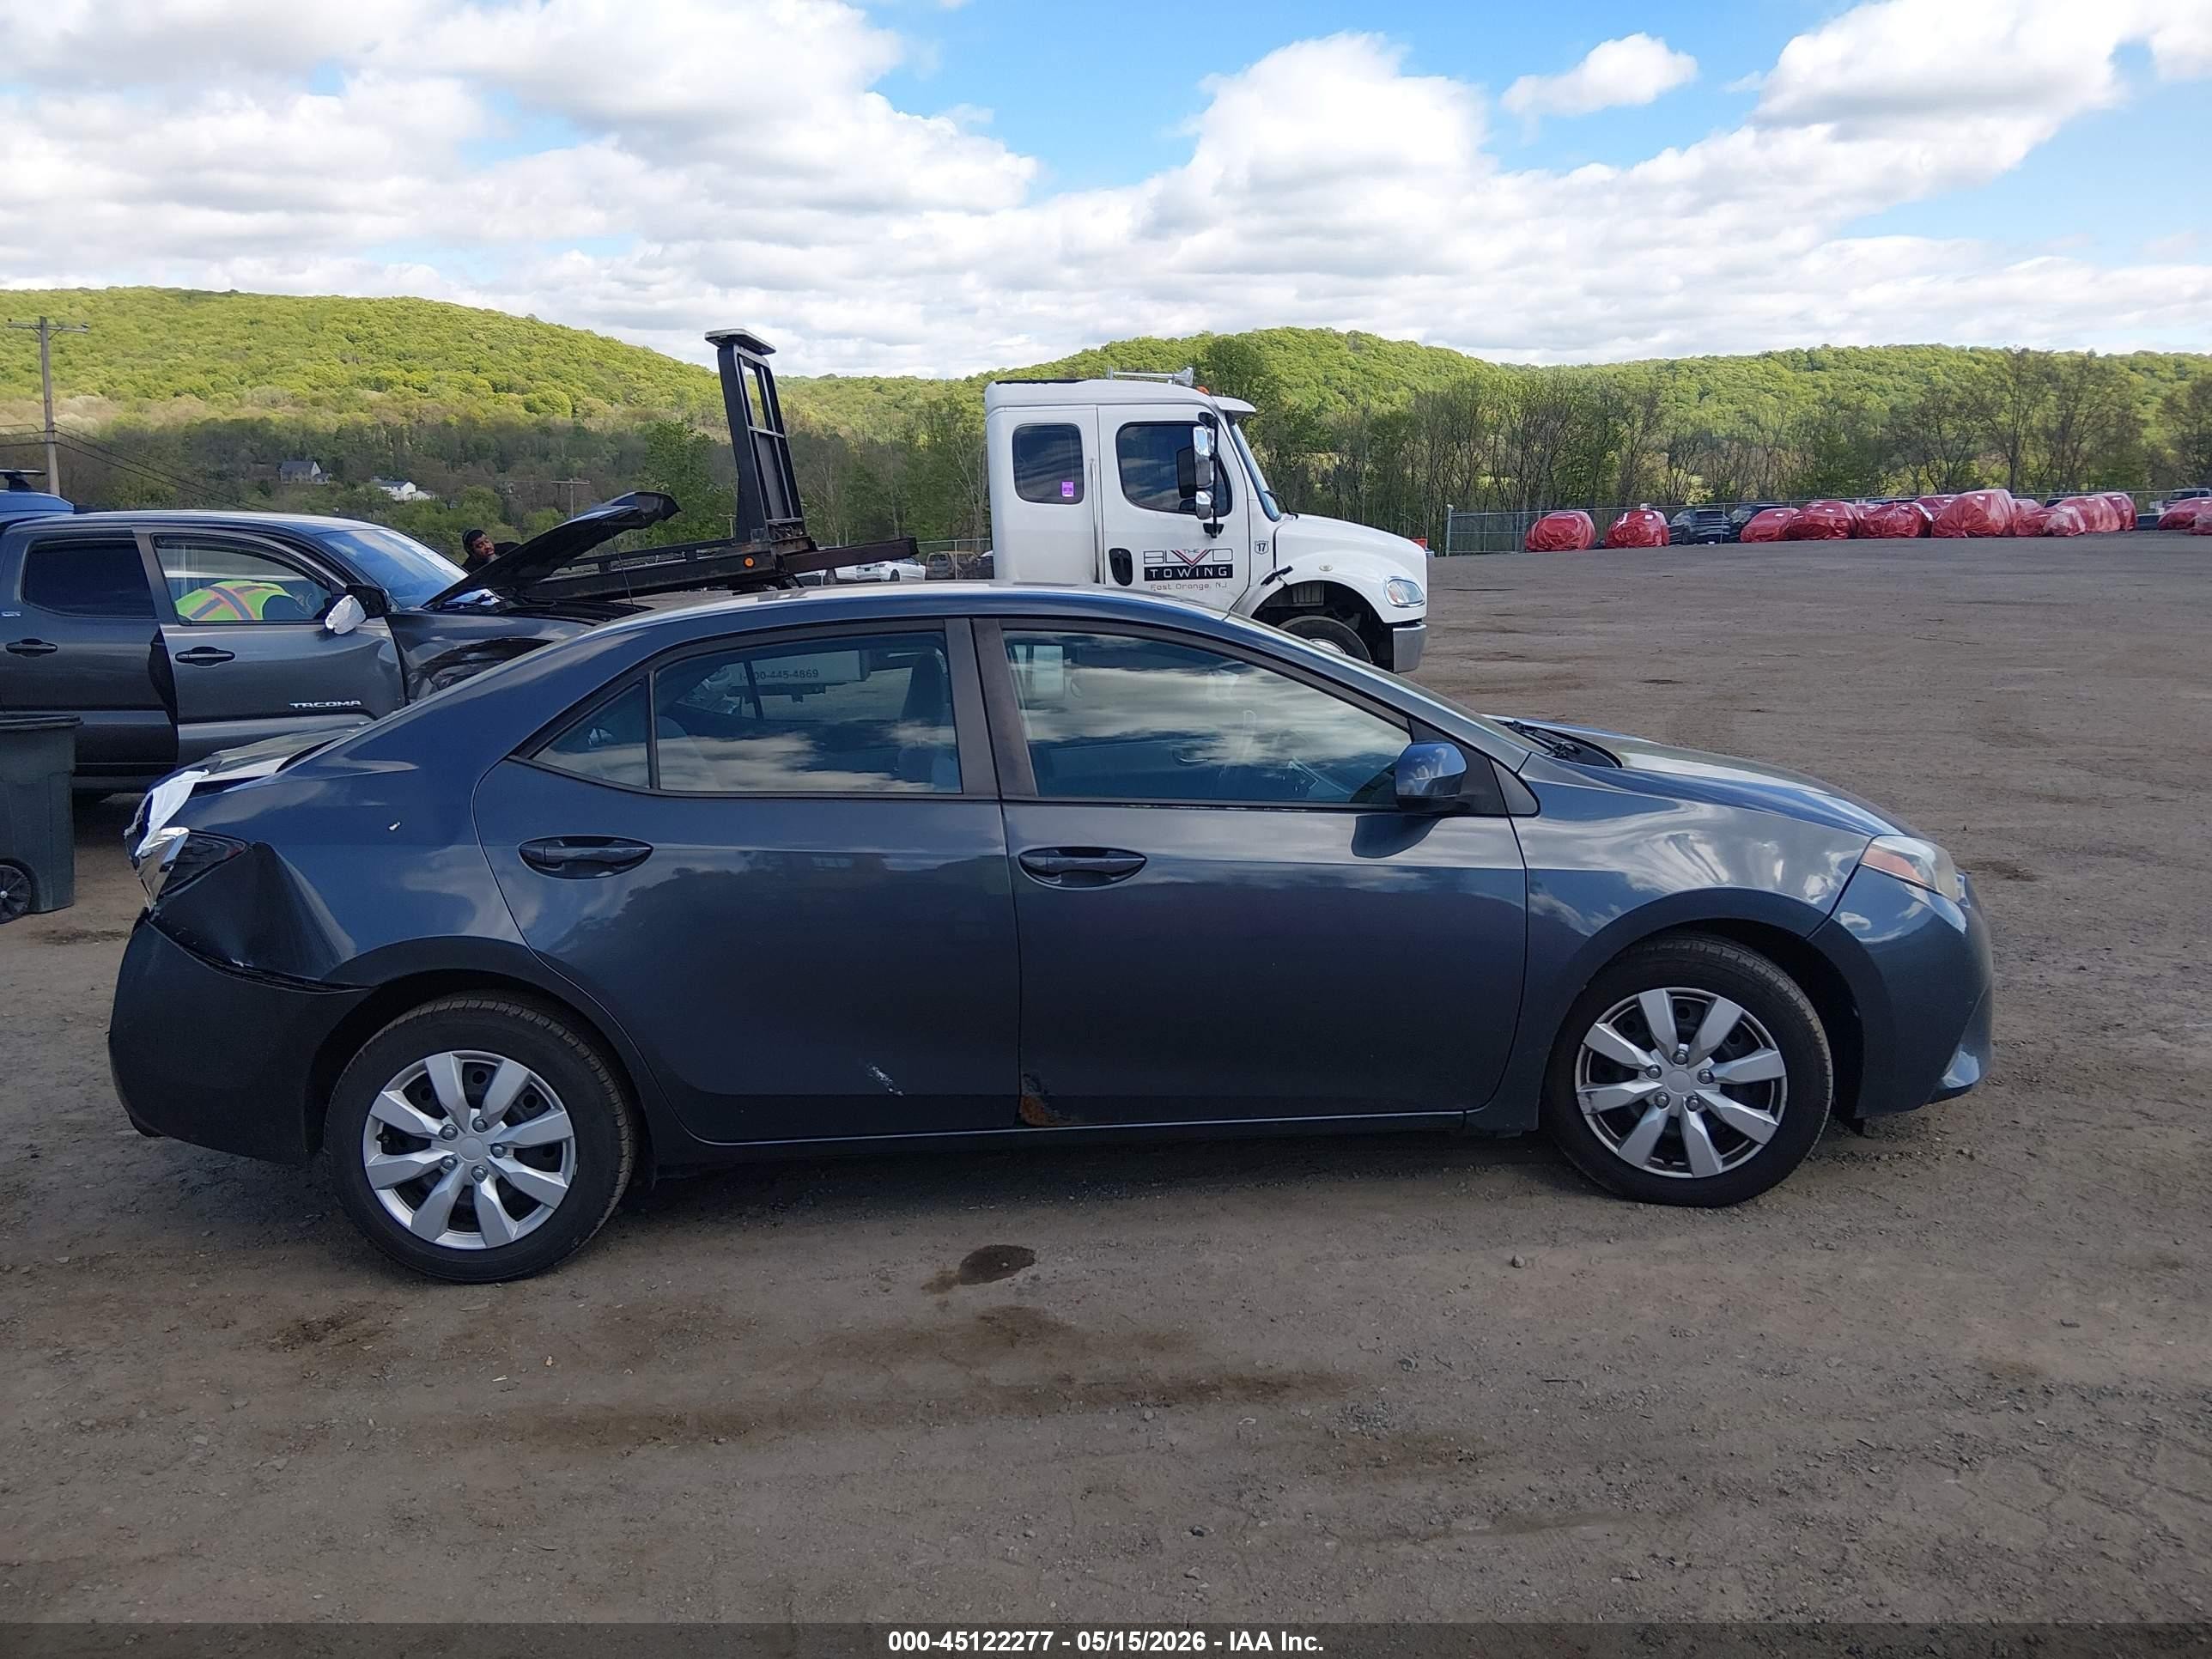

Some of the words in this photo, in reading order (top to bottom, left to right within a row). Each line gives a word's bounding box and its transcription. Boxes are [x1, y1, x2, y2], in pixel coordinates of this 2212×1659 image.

[1256, 542, 1267, 552] 17
[1143, 548, 1234, 567] BLVD
[1150, 567, 1228, 578] TOWING
[289, 700, 362, 708] TACOMA
